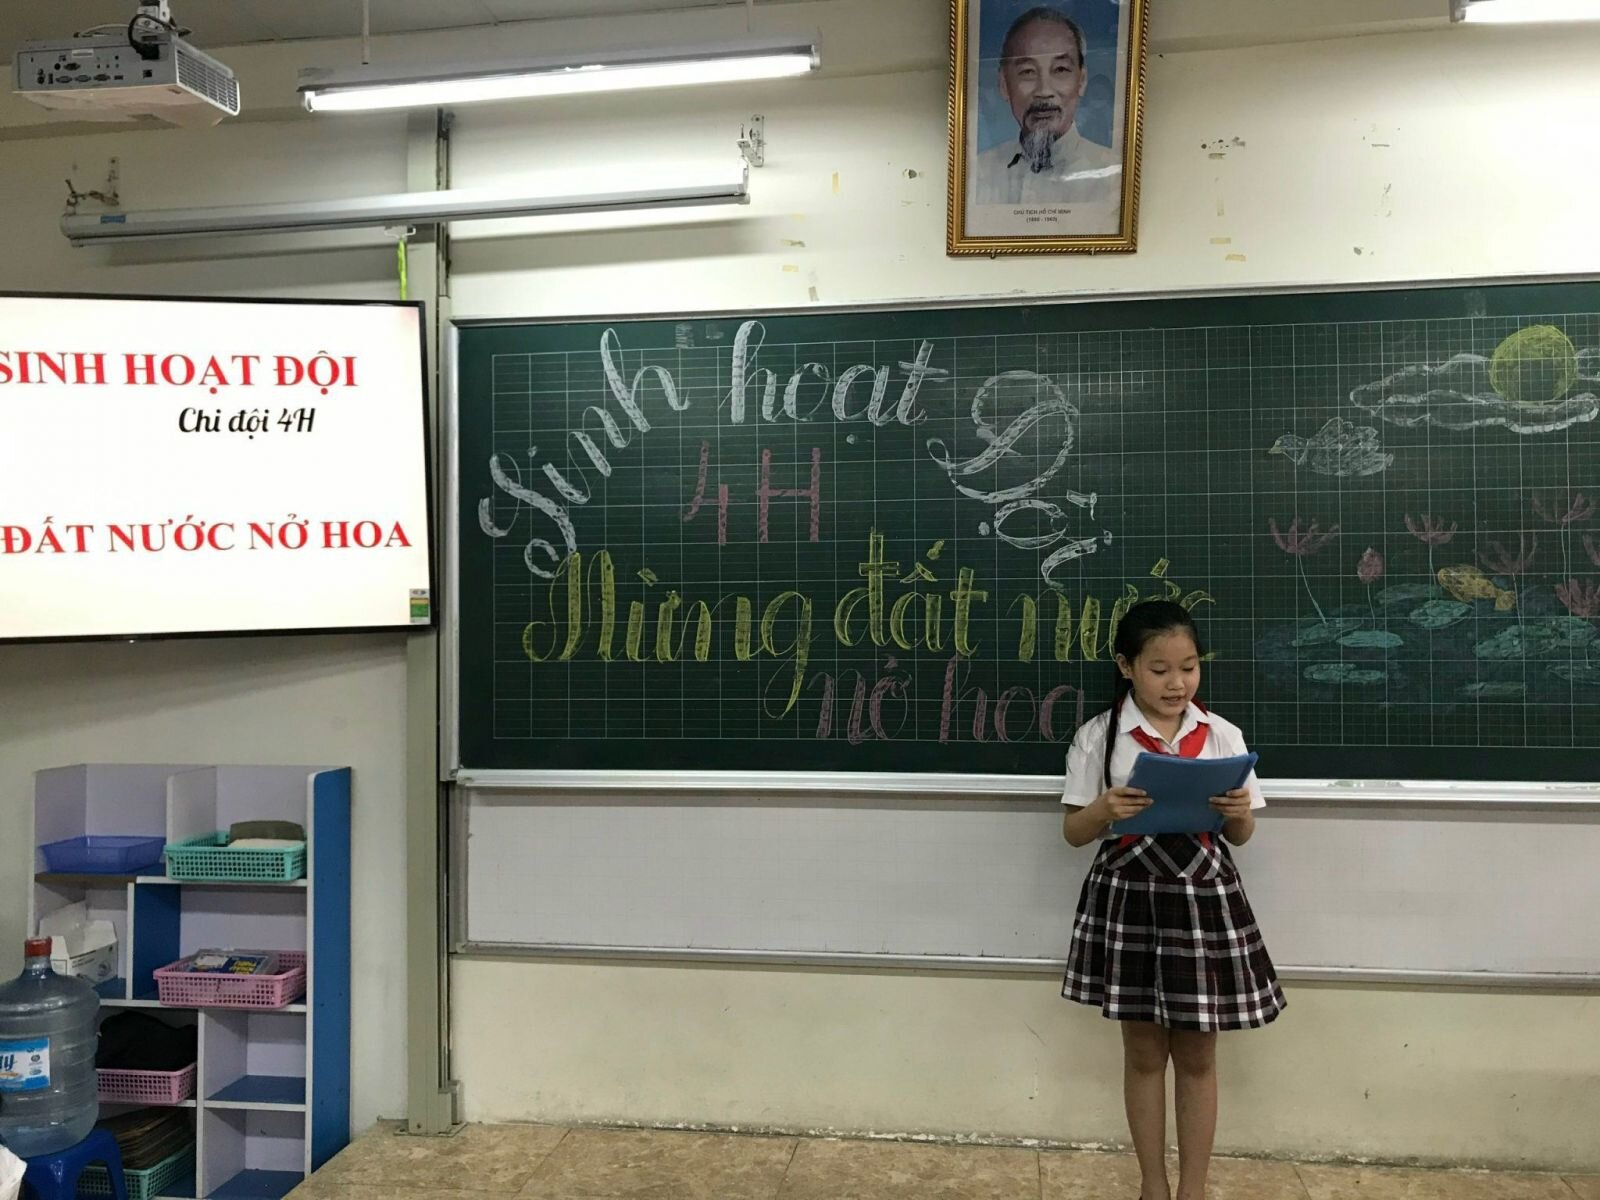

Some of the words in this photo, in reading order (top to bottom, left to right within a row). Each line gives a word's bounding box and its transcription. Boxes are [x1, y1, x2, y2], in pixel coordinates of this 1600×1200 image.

[0, 350, 108, 385] SINH
[121, 353, 261, 395] HOẠT
[273, 350, 359, 396] ĐỘI
[178, 407, 222, 433] Chi
[228, 408, 270, 440] đội
[277, 407, 316, 433] 4H
[477, 327, 691, 579] Sinh
[717, 320, 949, 445] hoạt
[0, 516, 94, 554] ĐẤT
[107, 515, 234, 553] NƯỚC
[248, 513, 310, 551] NỞ
[321, 520, 412, 549] HOA
[681, 441, 821, 546] 4H
[834, 527, 988, 657] đất
[936, 655, 1084, 744] hoa
